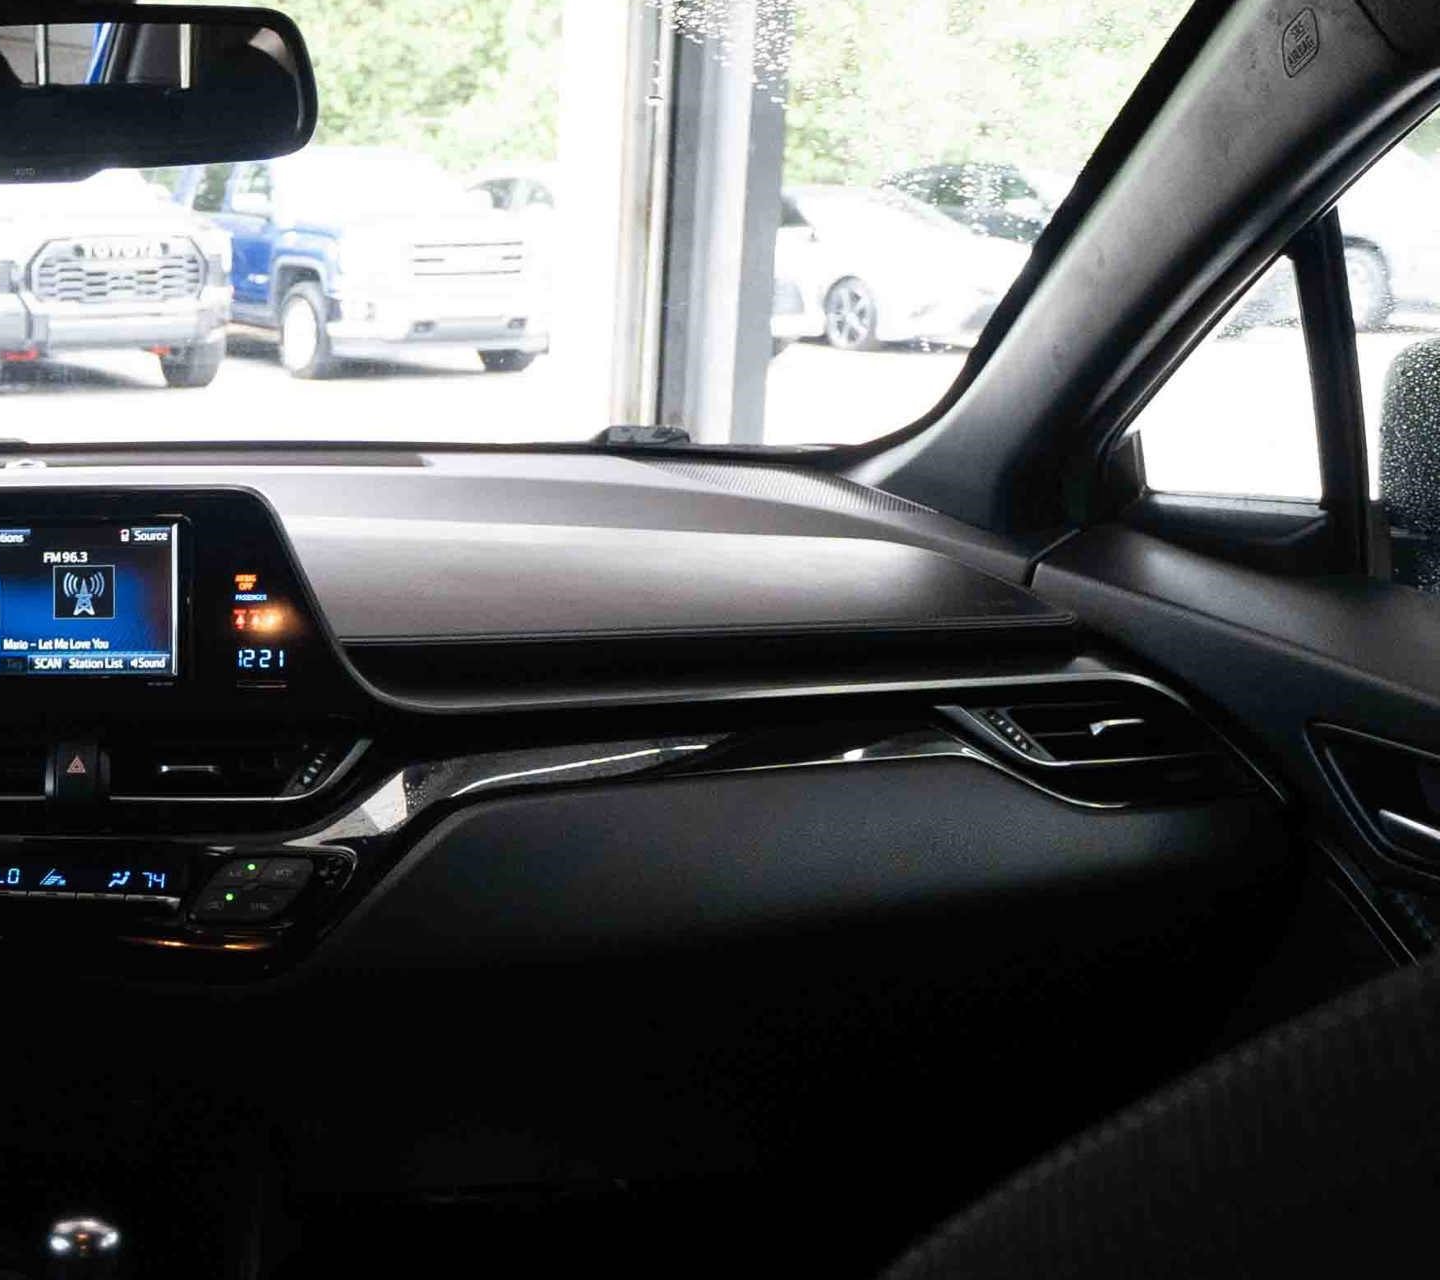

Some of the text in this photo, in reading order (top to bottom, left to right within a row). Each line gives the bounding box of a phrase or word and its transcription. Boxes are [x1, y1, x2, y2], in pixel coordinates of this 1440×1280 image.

[134, 530, 168, 542] Source
[43, 552, 88, 564] FM 96.3
[38, 638, 53, 651] Let
[54, 639, 69, 651] Me
[70, 639, 91, 651] Love
[92, 638, 110, 651] You
[34, 658, 63, 669] SCAN
[68, 658, 123, 669] Station List
[139, 657, 167, 669] Sound
[141, 870, 167, 889] 74
